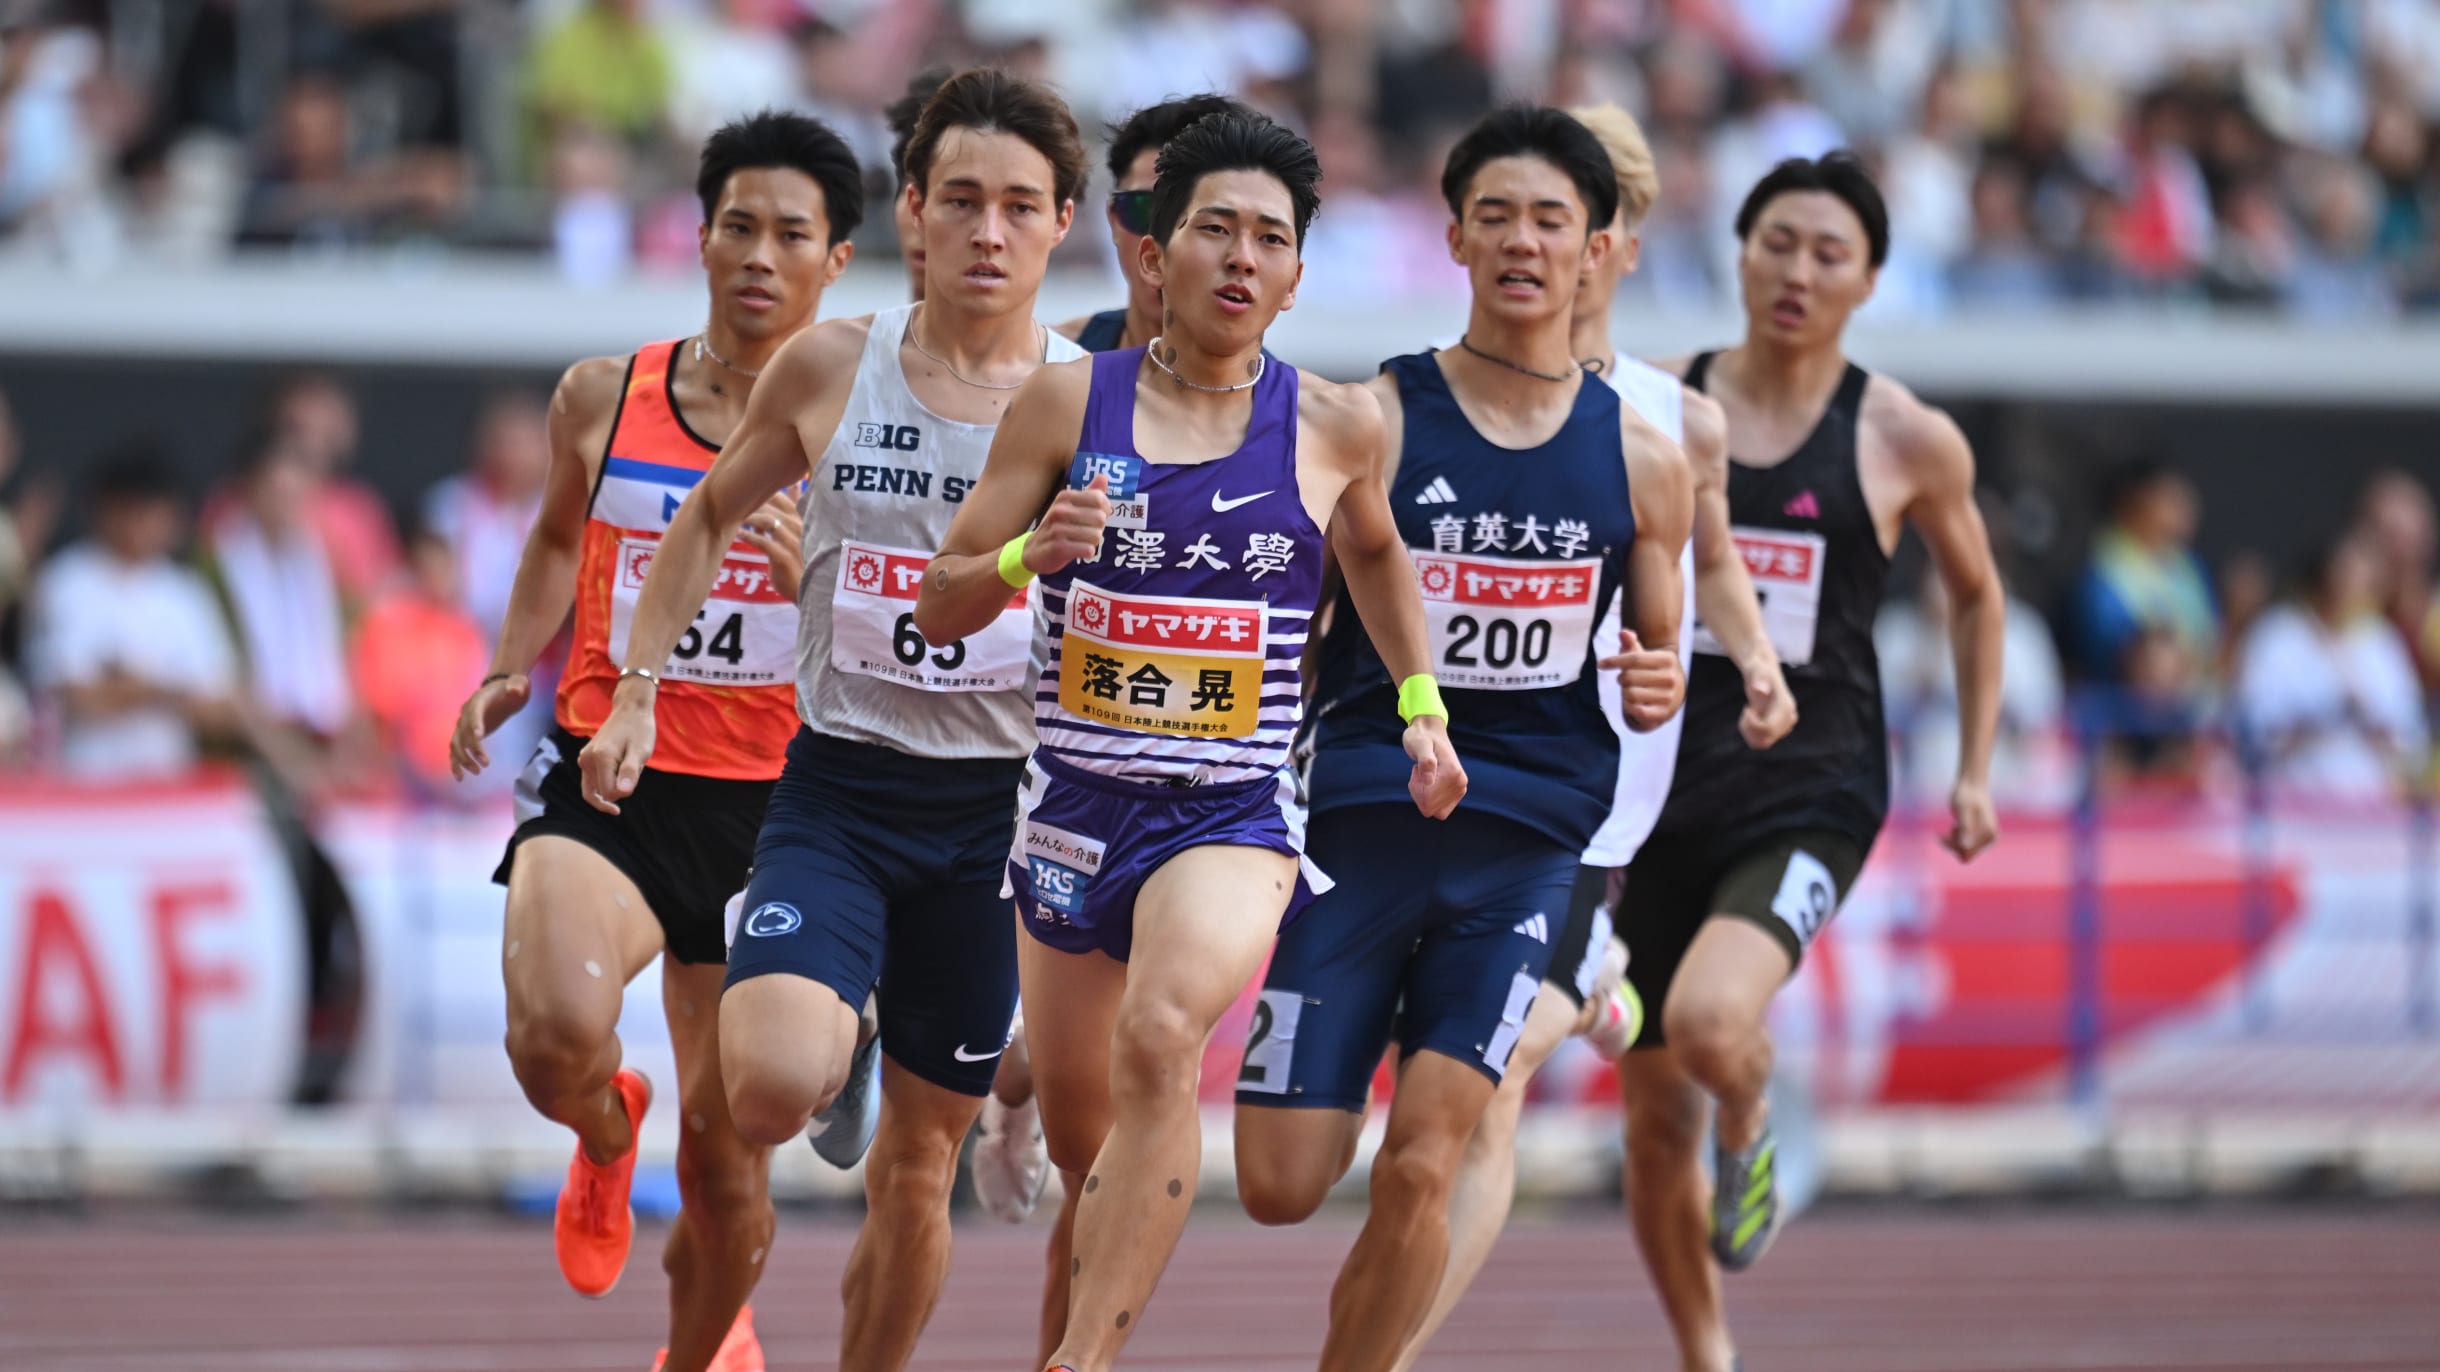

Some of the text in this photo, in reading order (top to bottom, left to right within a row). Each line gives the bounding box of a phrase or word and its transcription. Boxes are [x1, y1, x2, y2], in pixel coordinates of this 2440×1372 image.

[833, 464, 977, 504] PENN S
[1083, 457, 1128, 484] HRS
[1430, 512, 1591, 560] 育英大学
[1463, 570, 1585, 601] ヤマザキ
[1118, 609, 1250, 643] ヤマザキ
[1443, 614, 1553, 670] 200
[859, 660, 897, 677] 第109回
[1081, 652, 1235, 713] 落合 晃
[1082, 704, 1228, 733] 第109回 日本陸上競技選手権大会
[1027, 832, 1100, 867] みんなの介護
[1035, 863, 1075, 895] HRS
[1239, 1000, 1273, 1084] 2
